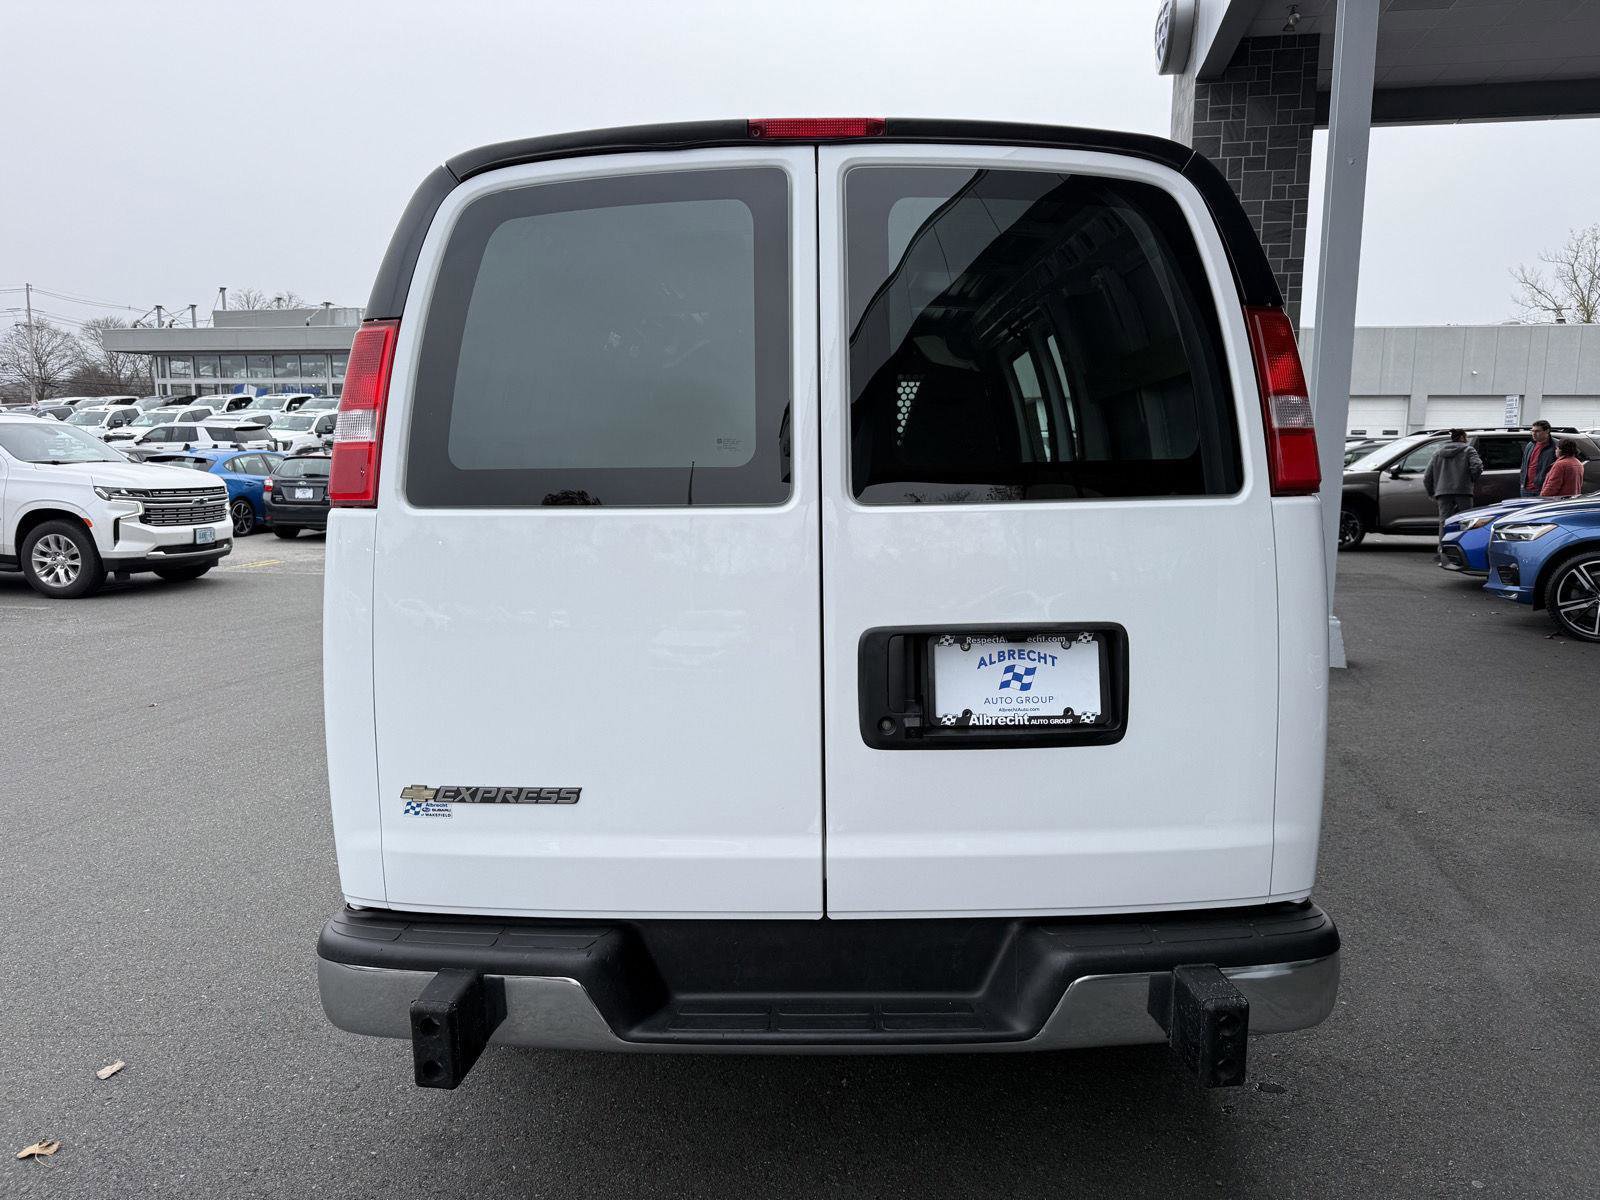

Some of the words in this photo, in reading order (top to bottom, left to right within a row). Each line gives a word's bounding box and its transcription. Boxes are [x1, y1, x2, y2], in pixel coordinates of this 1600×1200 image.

[977, 648, 1058, 669] ALBRECHT
[984, 697, 1013, 705] AUTO
[1016, 695, 1054, 704] GROUP
[969, 713, 1029, 726] Albrecht
[435, 786, 581, 804] EXPRESS
